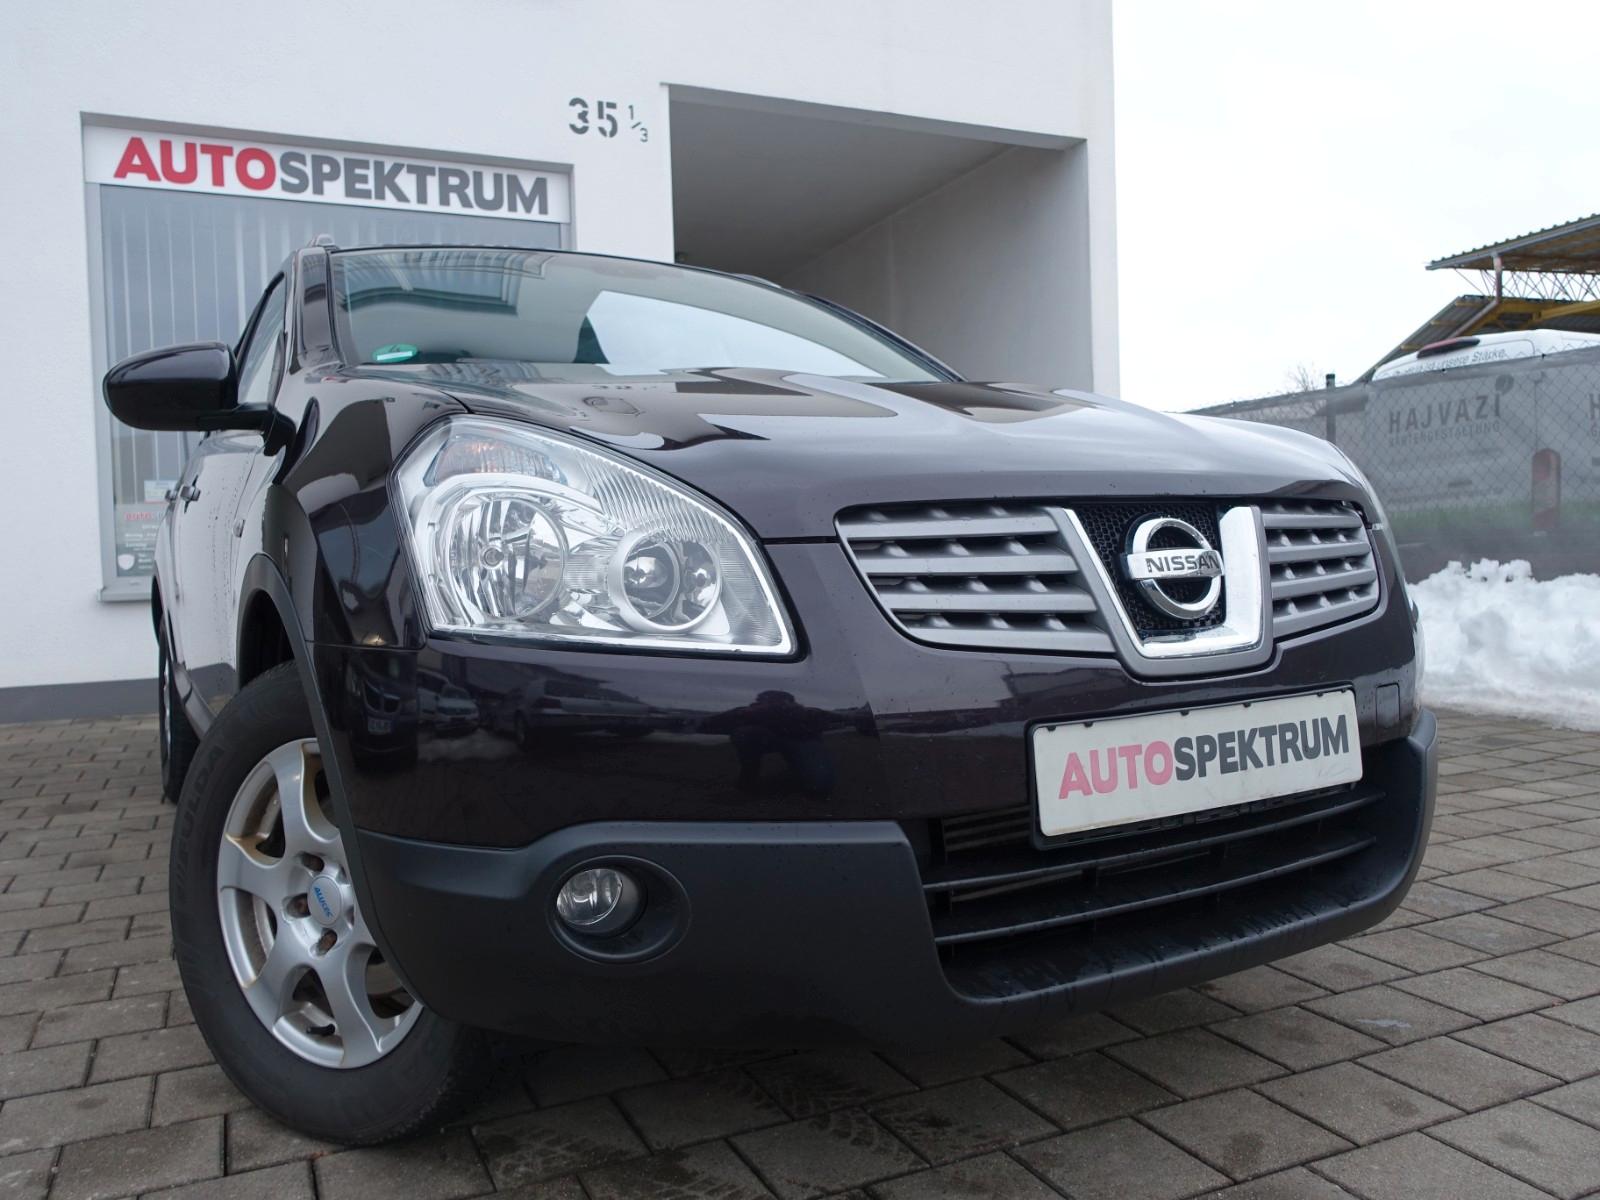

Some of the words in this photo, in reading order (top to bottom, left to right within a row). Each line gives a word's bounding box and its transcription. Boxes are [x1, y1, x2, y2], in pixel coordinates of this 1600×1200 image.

[568, 97, 618, 138] 35
[113, 136, 549, 216] AUTOSPEKTRUM
[1388, 393, 1502, 434] HAJVAZI
[1145, 554, 1220, 573] NISSAN
[1058, 714, 1349, 800] AUTOSPEKTRUM
